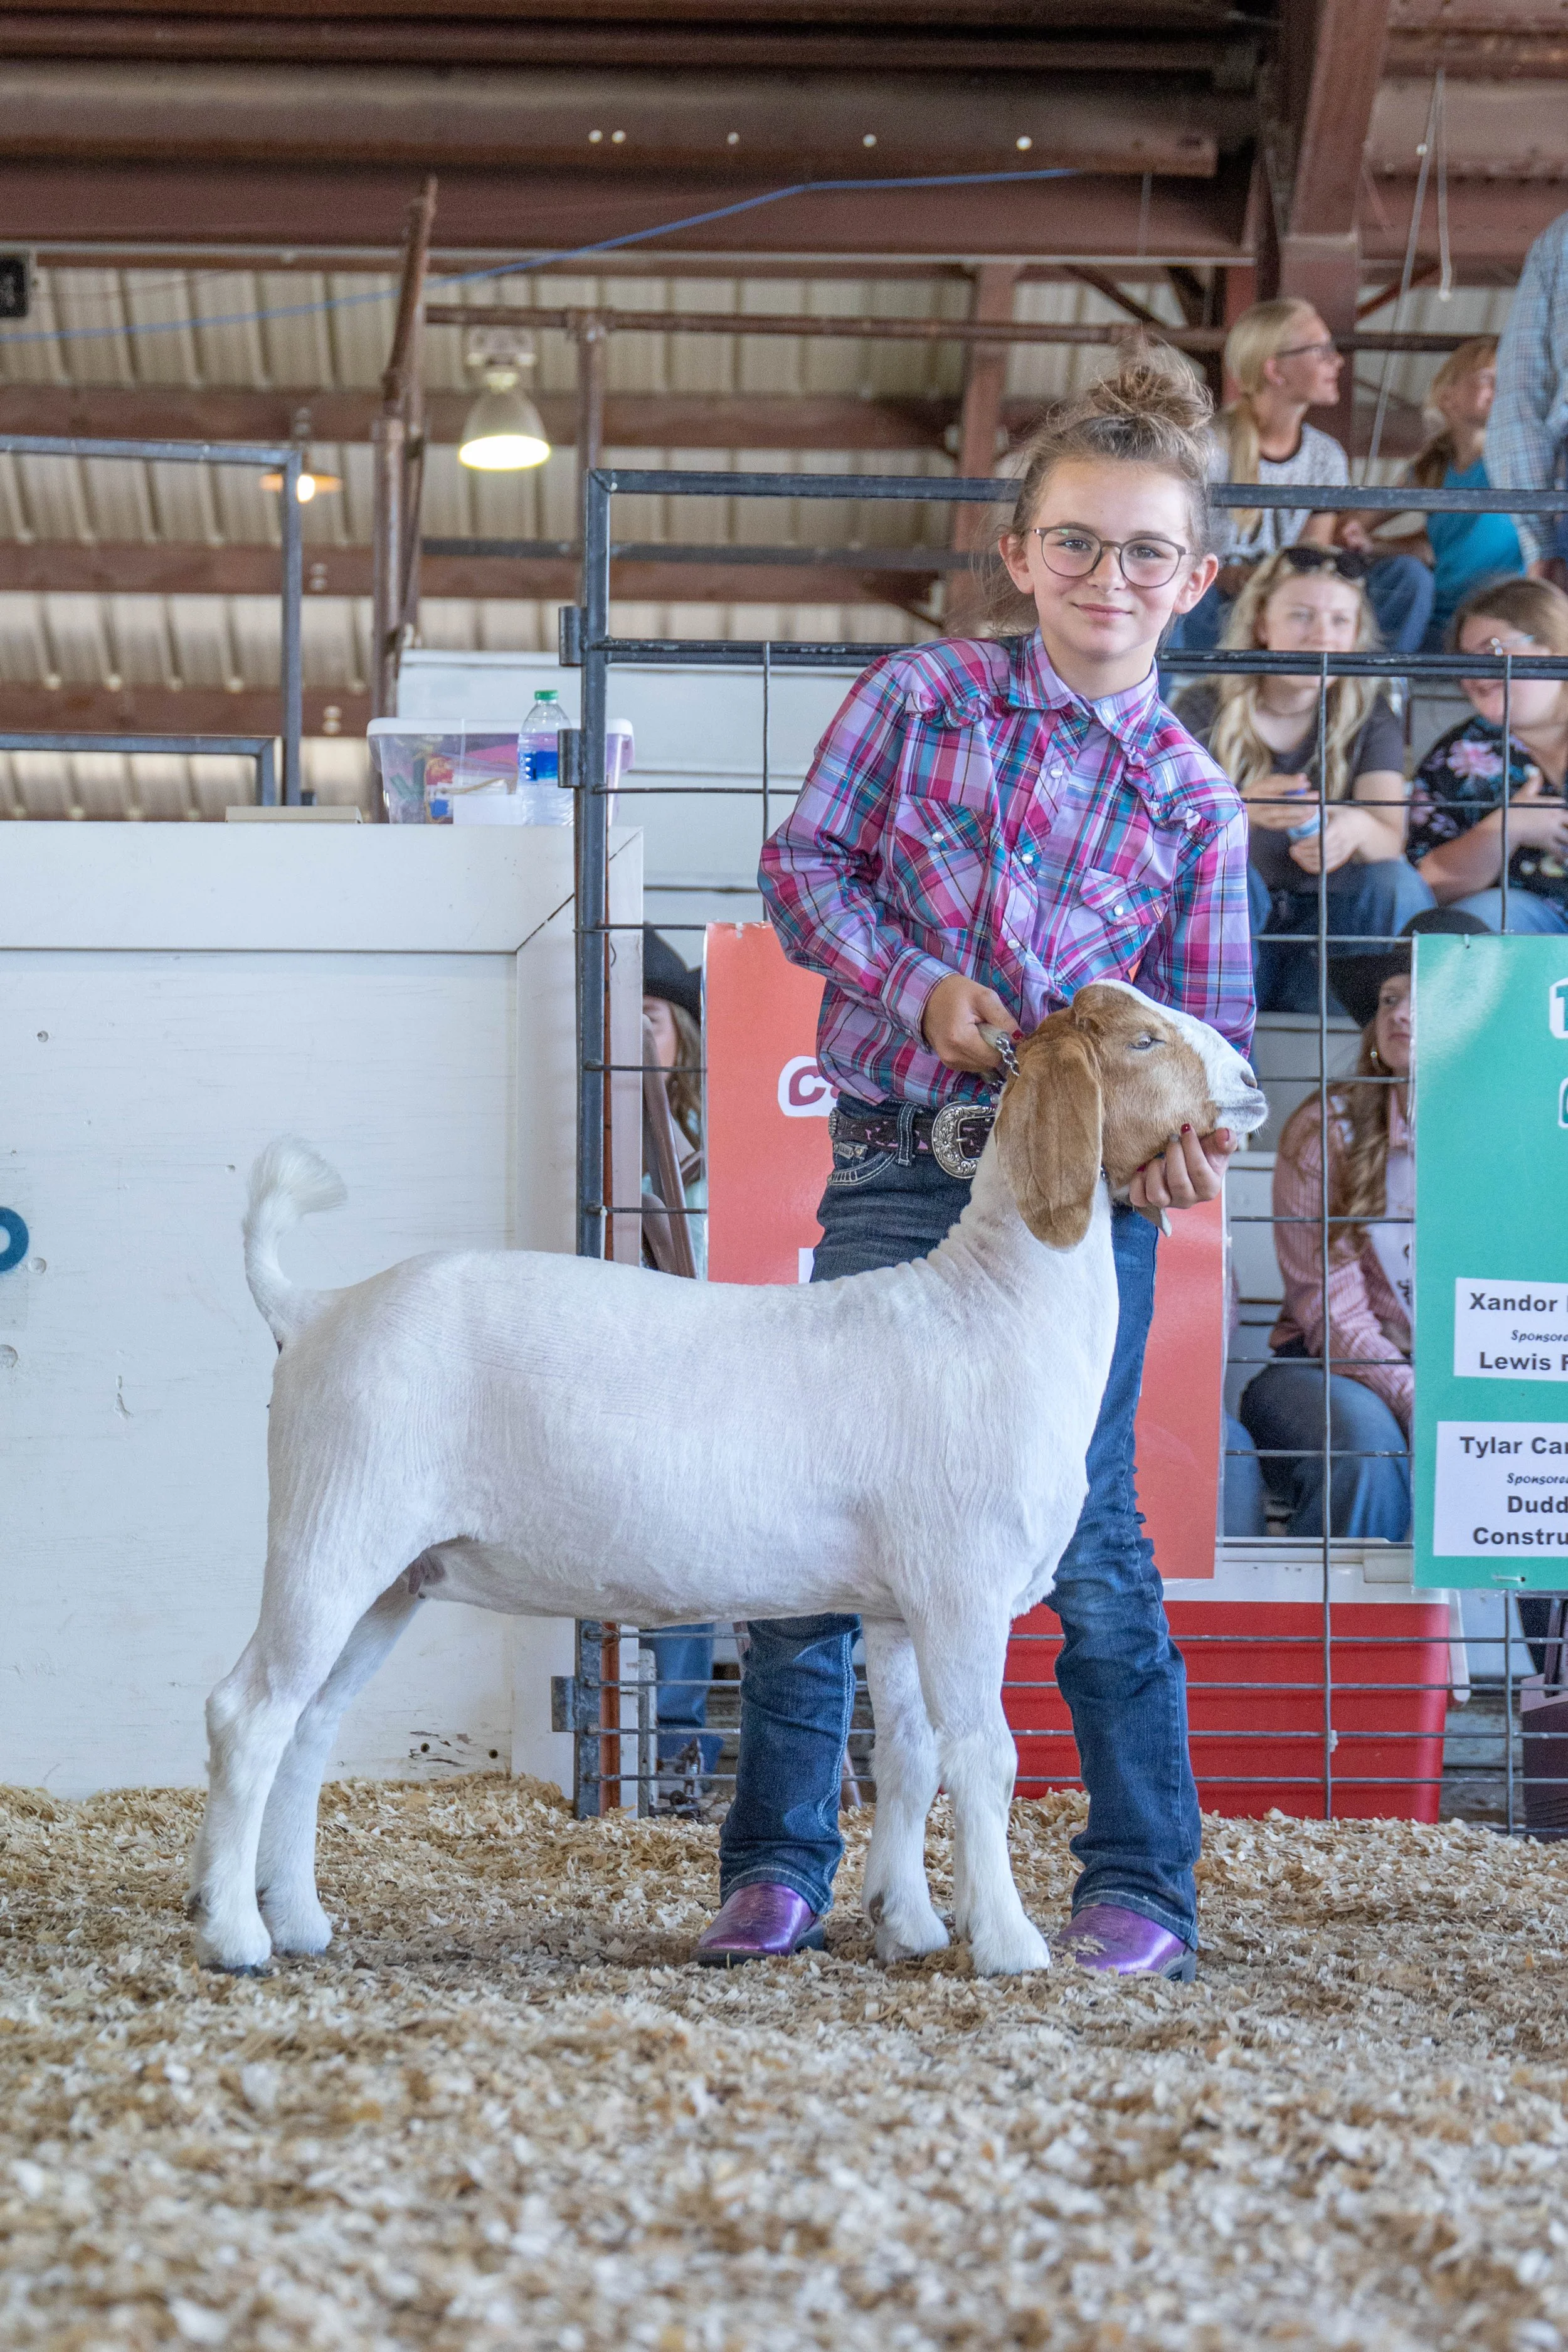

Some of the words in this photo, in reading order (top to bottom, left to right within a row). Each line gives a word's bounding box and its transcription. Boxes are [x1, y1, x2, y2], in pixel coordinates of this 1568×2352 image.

[1469, 1292, 1559, 1312] Xandor
[1480, 1351, 1552, 1371] Lewis
[1459, 1436, 1523, 1459] Tylar
[1507, 1495, 1568, 1513] Dudd
[1473, 1527, 1568, 1545] Constru
